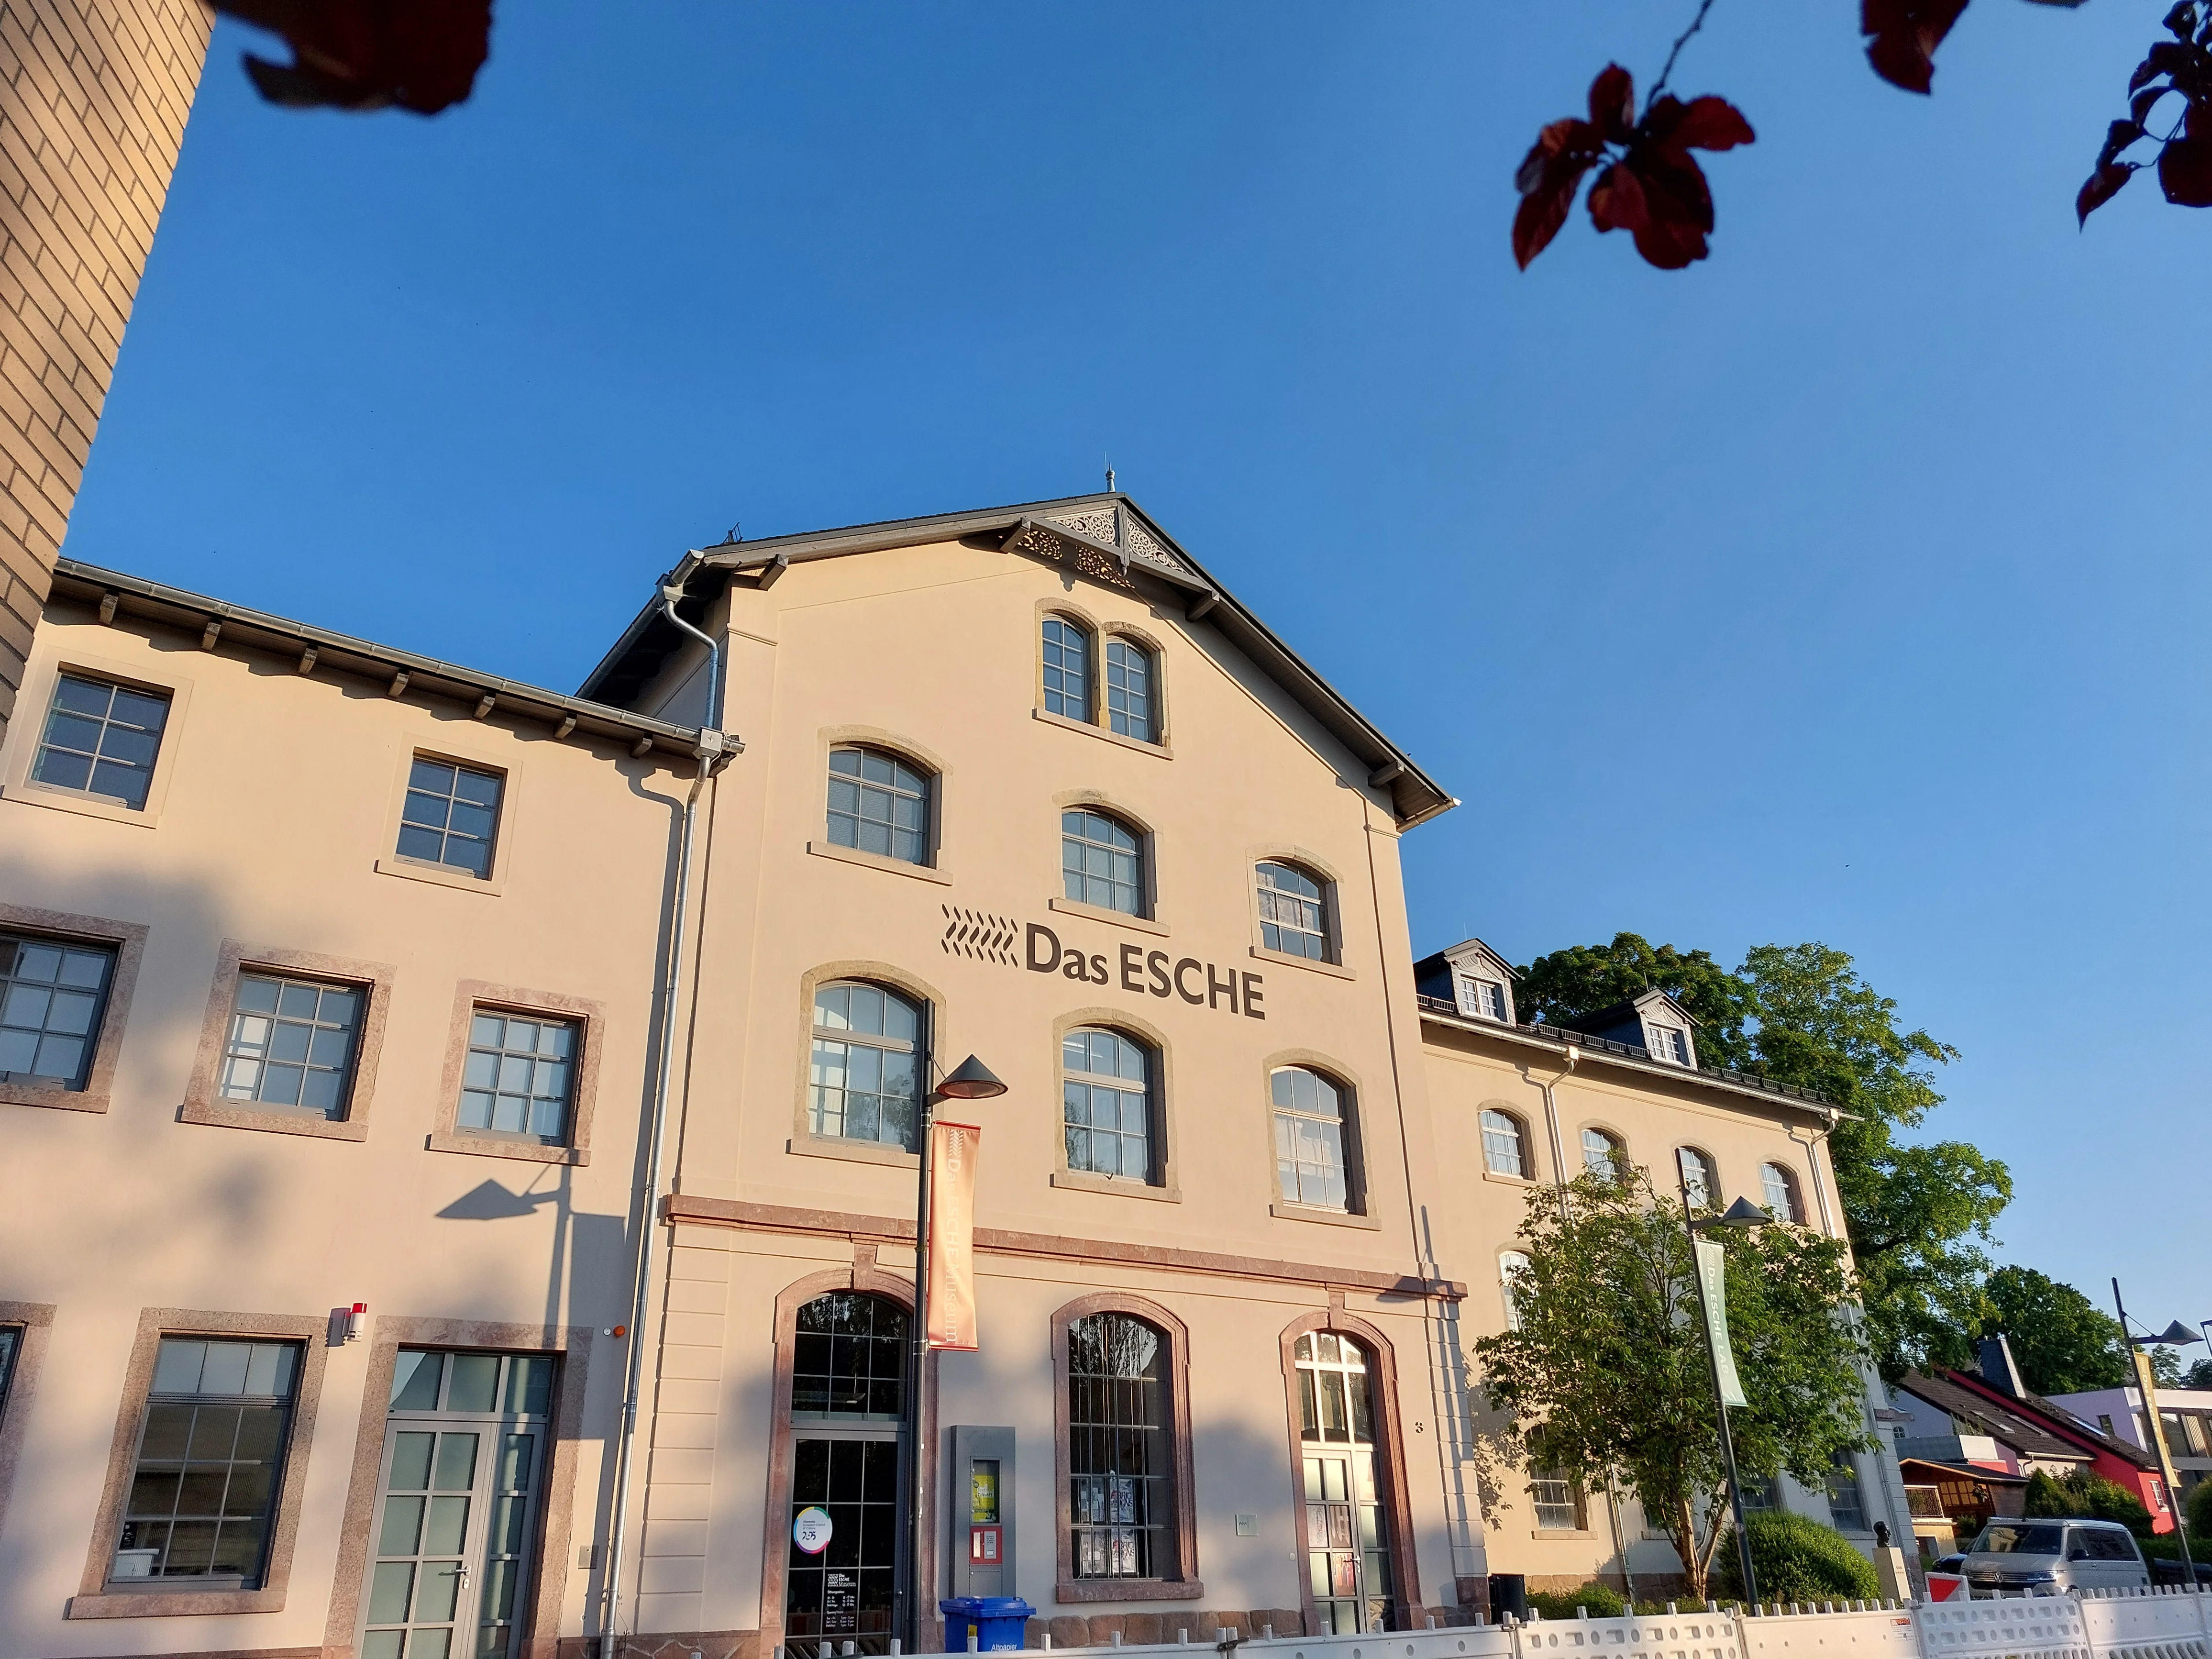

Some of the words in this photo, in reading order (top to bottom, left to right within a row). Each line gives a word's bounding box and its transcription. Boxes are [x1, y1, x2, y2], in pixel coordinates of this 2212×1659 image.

[1026, 922, 1108, 985] Das
[1120, 943, 1265, 1020] ESCHE
[947, 1159, 961, 1190] Das
[946, 1196, 960, 1261] ESCHE
[945, 1264, 958, 1343] Museum
[1710, 1294, 1723, 1340] ESCHE
[1717, 1344, 1729, 1374] LAB
[1415, 1421, 1424, 1434] 3
[2146, 1396, 2158, 1433] ESCHE
[990, 1643, 1018, 1651] Altpapier
